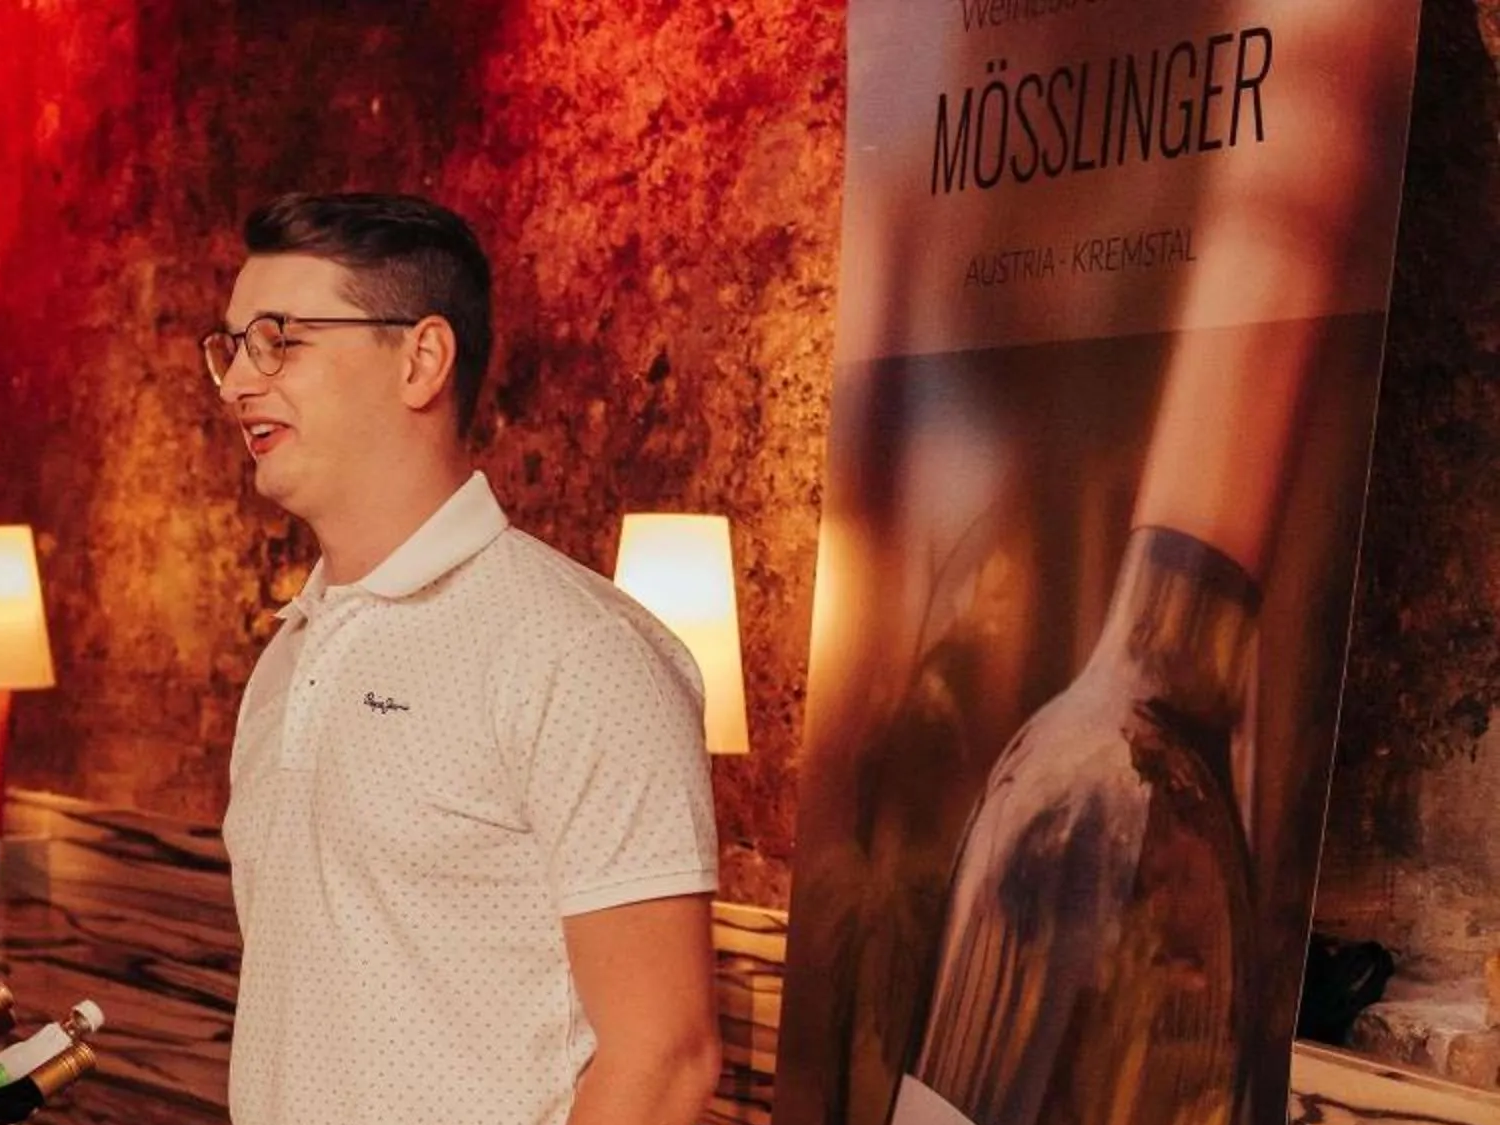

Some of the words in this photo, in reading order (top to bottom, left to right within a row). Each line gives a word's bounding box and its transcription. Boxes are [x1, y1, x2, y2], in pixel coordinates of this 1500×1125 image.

[930, 27, 1274, 196] MÖSSLINGER
[963, 246, 1056, 287] AUSTRIA
[1071, 226, 1199, 275] KREMSTAL
